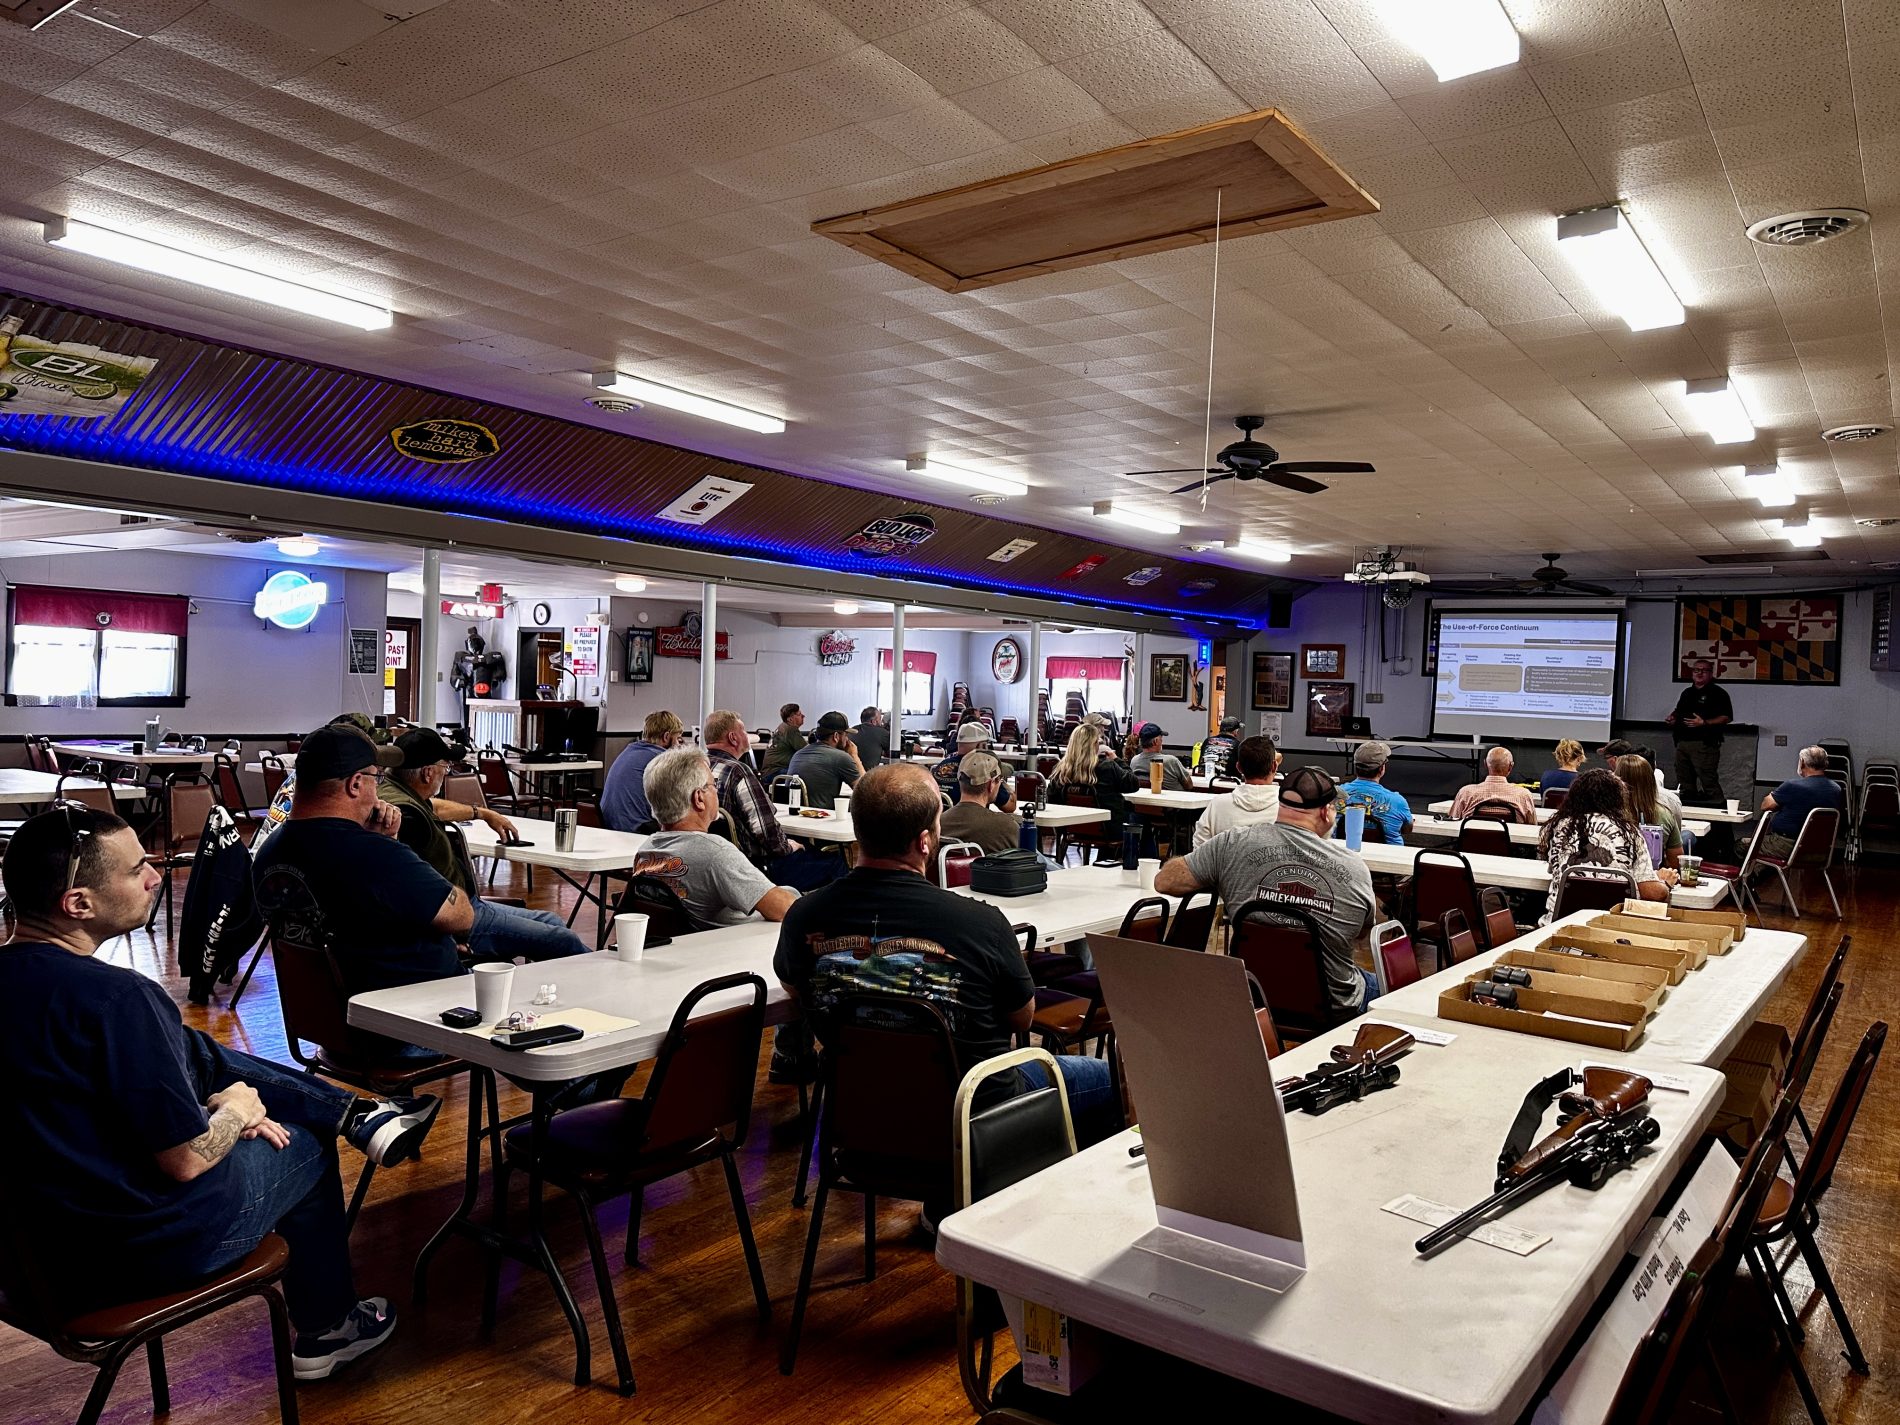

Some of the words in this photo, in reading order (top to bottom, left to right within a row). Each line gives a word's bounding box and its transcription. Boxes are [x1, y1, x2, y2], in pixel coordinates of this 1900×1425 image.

[30, 354, 107, 382] BL
[423, 422, 480, 440] mike's
[399, 436, 483, 457] lemonade
[427, 432, 478, 450] hard
[698, 491, 722, 502] Lite
[866, 519, 904, 536] BUD
[898, 523, 935, 544] LIGHT
[449, 602, 497, 618] ATM
[1452, 623, 1500, 632] Use-of-Force
[1500, 623, 1540, 632] Continuum
[388, 645, 406, 655] PAST
[823, 652, 853, 666] LIGHT
[385, 656, 402, 666] OINT
[1246, 844, 1304, 866] MYRTLE
[1307, 847, 1354, 885] BEACH
[1275, 867, 1321, 883] GENUINE
[1258, 888, 1333, 913] HARLEY-DAVIDSON
[817, 936, 866, 953] BATTLEFIELD
[876, 937, 940, 955] HARLEY-DAVIDSON
[1677, 1207, 1691, 1226] Case
[1646, 1252, 1664, 1279] Handle
[1663, 1254, 1685, 1287] Evidence
[1638, 1269, 1654, 1292] With
[1632, 1280, 1647, 1302] Care
